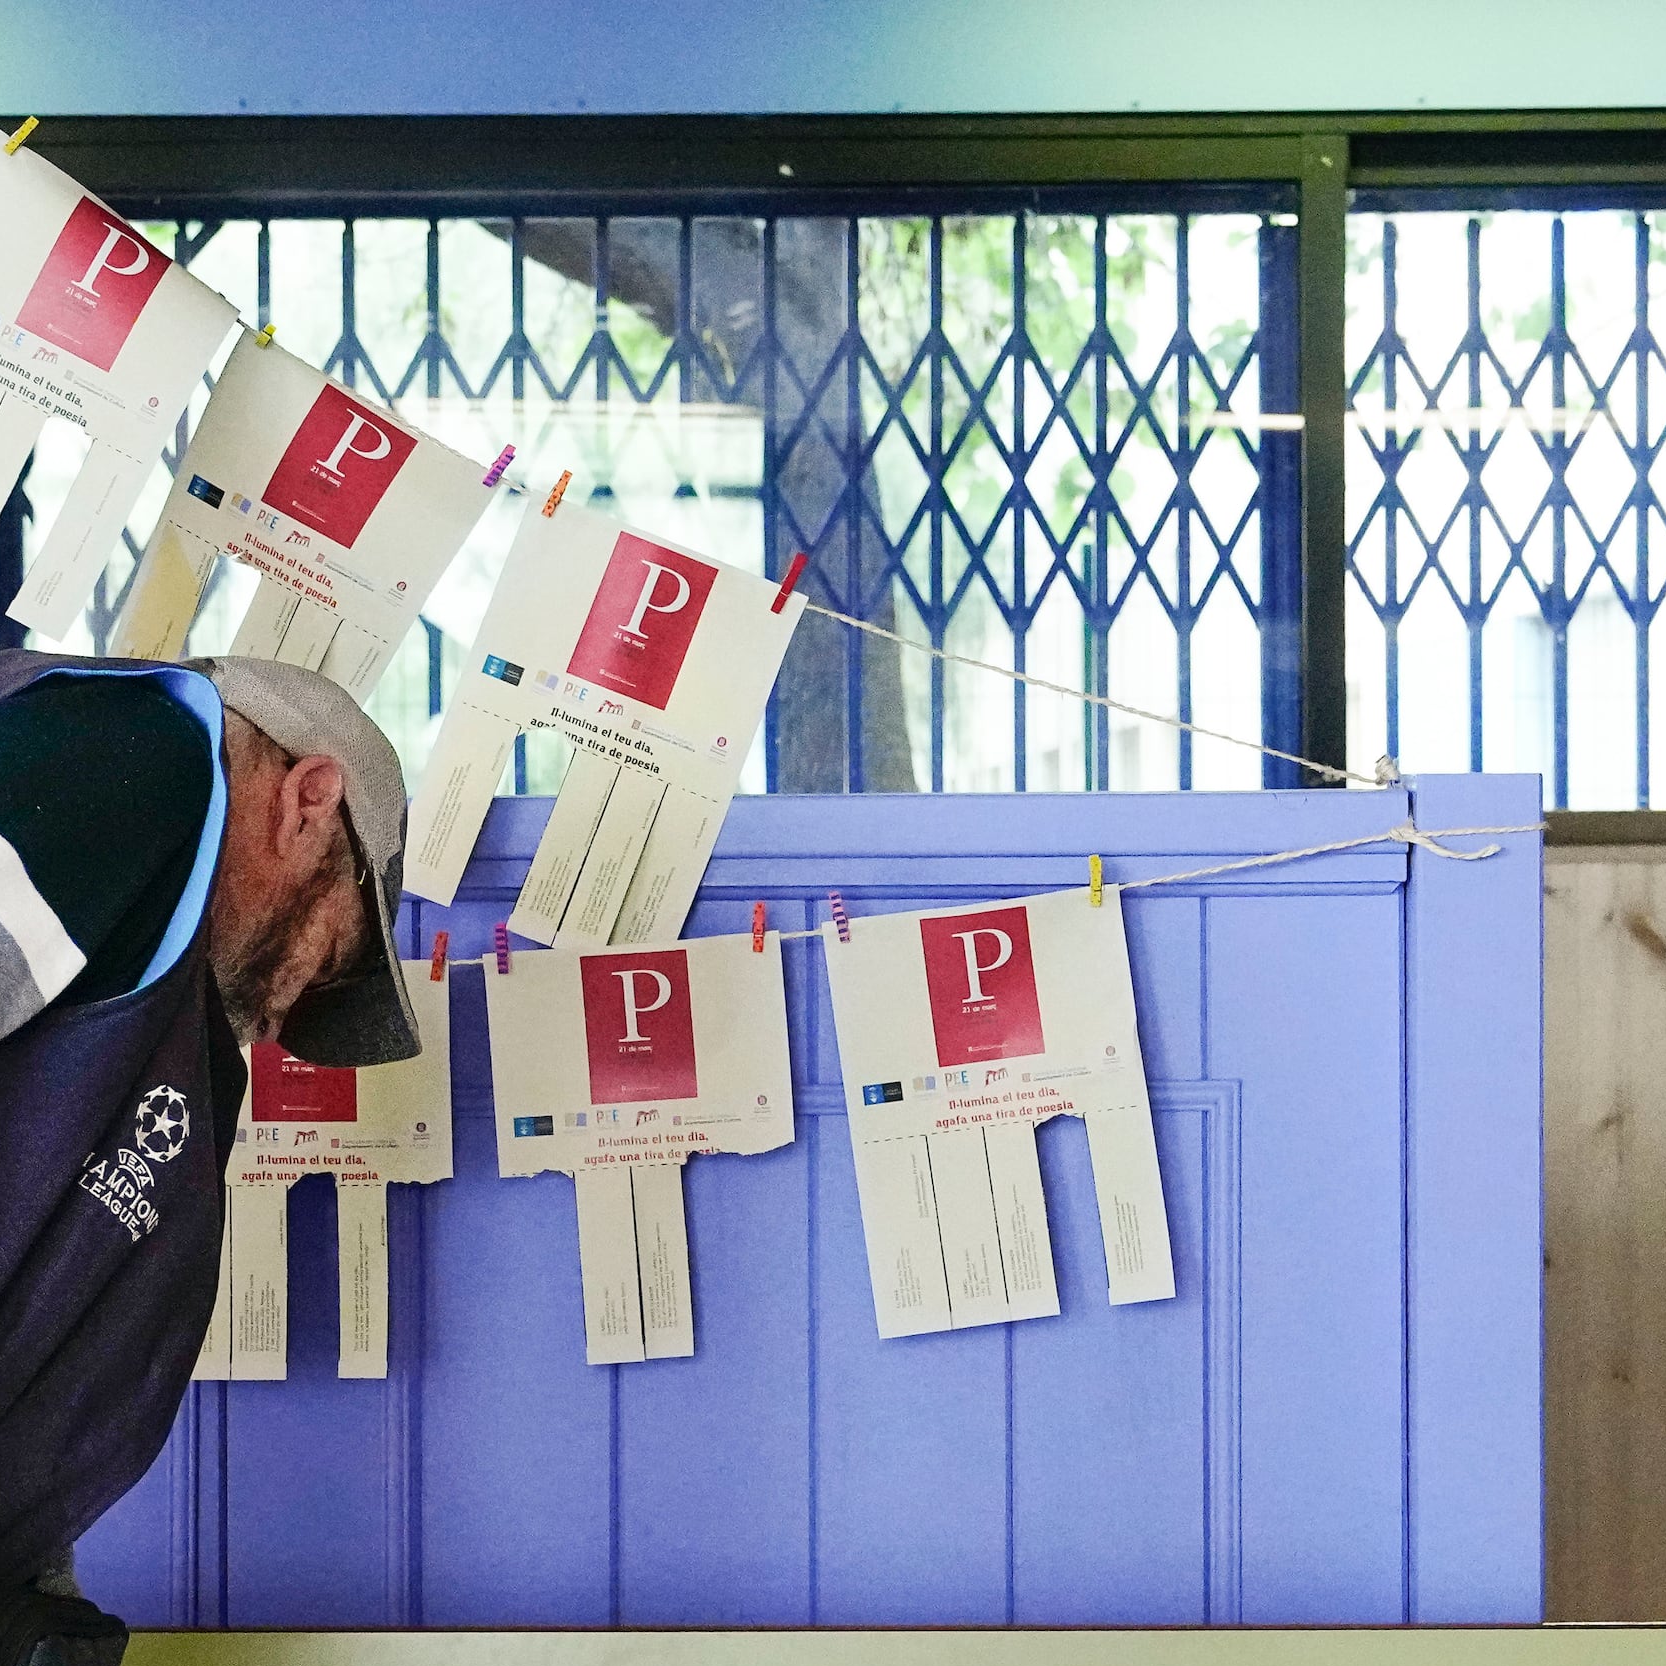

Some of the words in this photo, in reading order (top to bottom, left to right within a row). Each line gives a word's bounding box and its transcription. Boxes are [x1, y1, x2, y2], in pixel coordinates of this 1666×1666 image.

[71, 222, 149, 298] P
[33, 377, 44, 386] el
[46, 381, 62, 396] teu
[19, 386, 36, 400] tira
[39, 396, 51, 408] de
[53, 405, 87, 427] poesia
[317, 408, 391, 478] P
[255, 558, 271, 572] una
[273, 568, 289, 582] tira
[291, 578, 303, 590] de
[305, 587, 337, 608] poesia
[287, 559, 297, 568] el
[299, 564, 314, 578] teu
[618, 558, 691, 640] P
[601, 729, 612, 738] el
[615, 733, 631, 746] teu
[588, 740, 605, 752] tira
[609, 748, 622, 759] de
[624, 756, 659, 774] poesia
[952, 928, 1013, 1004] P
[611, 970, 671, 1042] P
[945, 1070, 969, 1086] PEE
[1003, 1092, 1013, 1103] el
[1017, 1090, 1033, 1100] teu
[936, 1116, 968, 1129] agafa
[972, 1114, 992, 1122] una
[997, 1110, 1015, 1120] tira
[1020, 1107, 1033, 1116] de
[1037, 1101, 1074, 1114] poesia
[653, 1134, 661, 1144] el
[666, 1133, 684, 1143] teu
[119, 1152, 151, 1187] UEFA
[310, 1155, 320, 1165] el
[323, 1156, 341, 1165] teu
[584, 1154, 615, 1166] agafa
[619, 1154, 640, 1162] una
[644, 1150, 664, 1160] tira
[668, 1148, 682, 1158] de
[242, 1171, 273, 1182] agafa
[277, 1172, 298, 1180] una
[342, 1171, 379, 1182] poesia
[83, 1152, 159, 1234] AMPION
